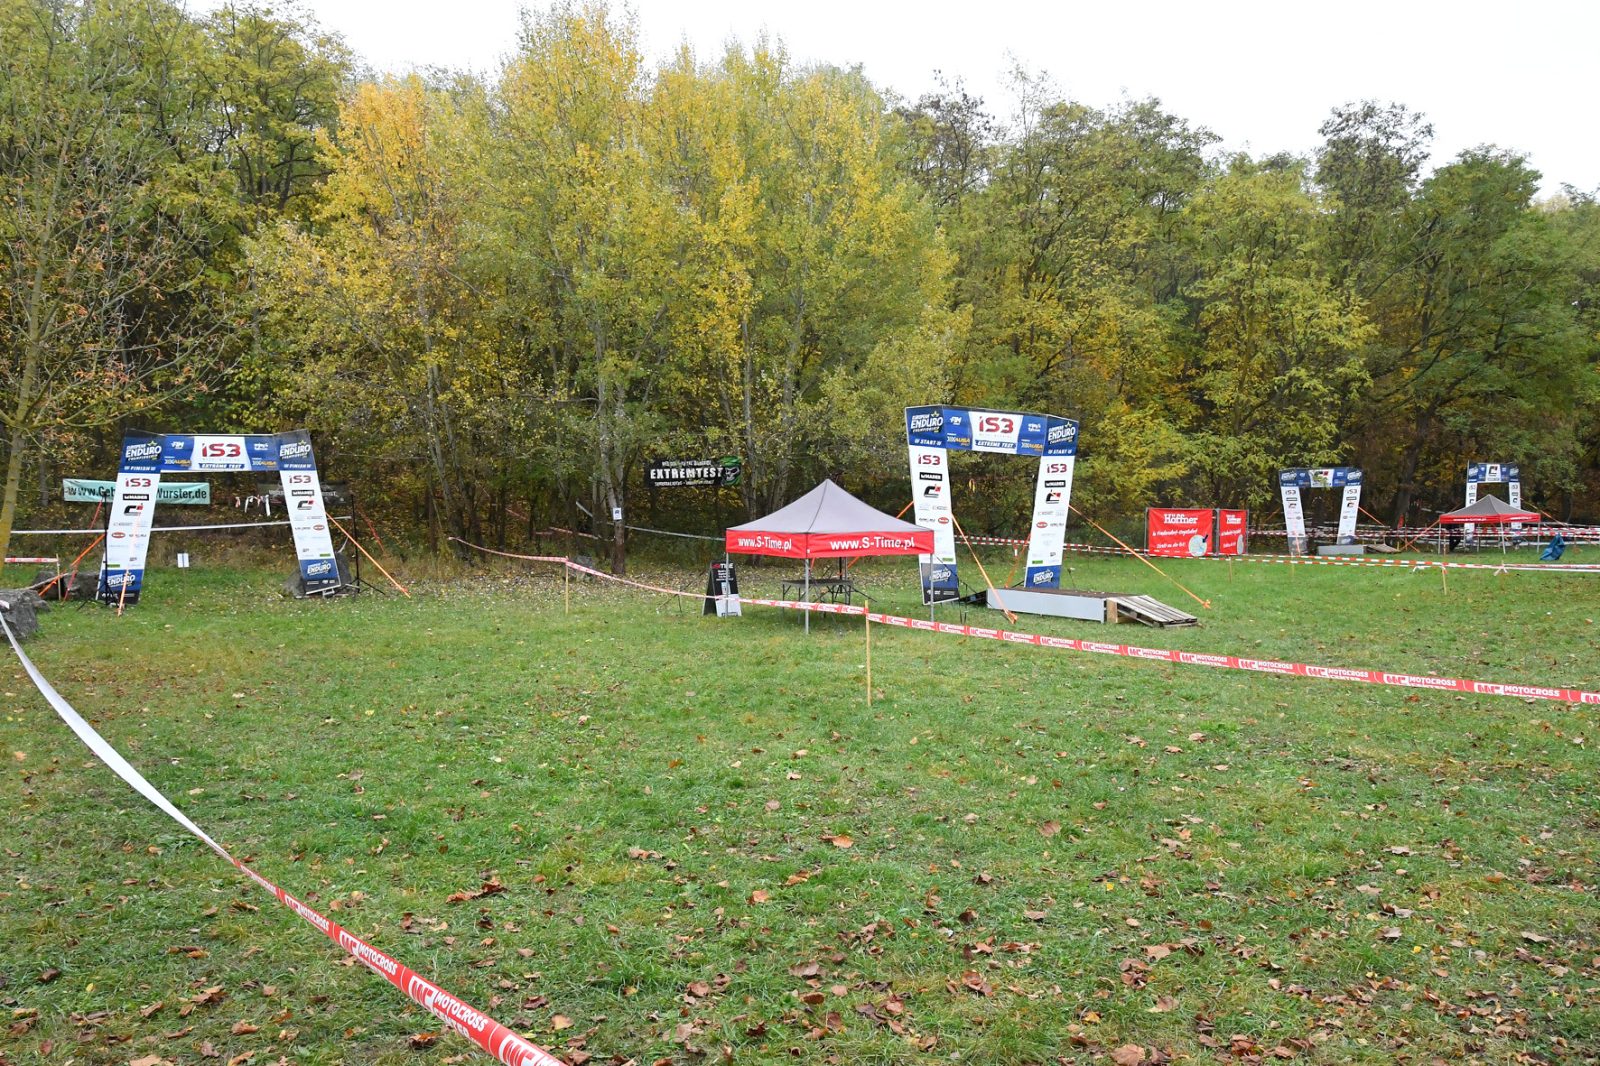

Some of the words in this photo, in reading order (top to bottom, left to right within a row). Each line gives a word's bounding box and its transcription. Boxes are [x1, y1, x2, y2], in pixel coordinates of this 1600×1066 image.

[911, 416, 944, 430] ENDURO
[1048, 427, 1076, 442] ENDURO
[126, 445, 162, 458] ENDURO
[280, 444, 311, 457] ENDURO
[918, 454, 940, 466] iS3
[650, 467, 724, 480] EXTREMTEST
[1047, 463, 1067, 474] iS3
[125, 478, 152, 487] iS3
[289, 476, 312, 484] iS3
[1164, 513, 1198, 524] Höffner
[738, 536, 792, 552] www.S-Time.pl
[830, 536, 915, 551] www.S-Time.pl
[1258, 661, 1293, 670] MOTOCROSS
[1328, 668, 1368, 678] MOTOCROSS
[1408, 676, 1456, 686] MOTOCROSS
[1504, 685, 1560, 697] MOTOCROSS
[359, 942, 398, 976] MOTOCROSS
[434, 992, 488, 1032] MOTOCROSS
